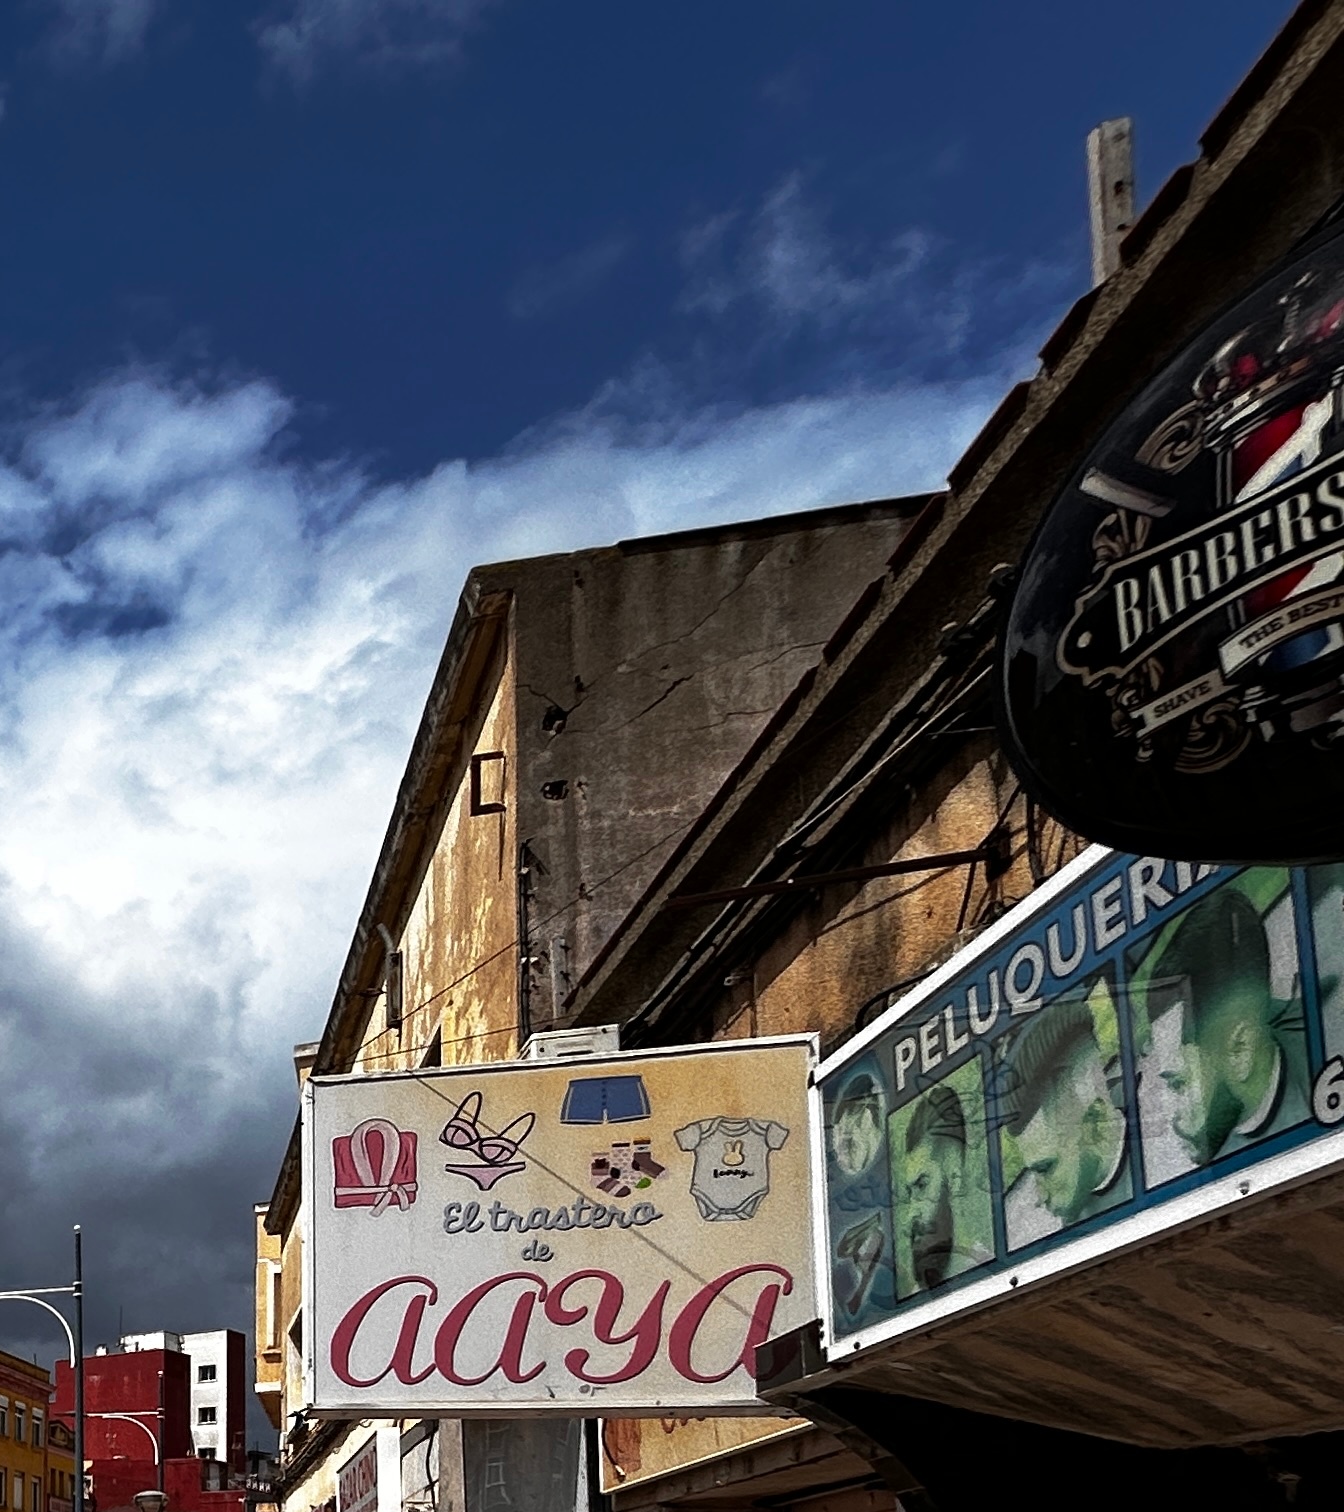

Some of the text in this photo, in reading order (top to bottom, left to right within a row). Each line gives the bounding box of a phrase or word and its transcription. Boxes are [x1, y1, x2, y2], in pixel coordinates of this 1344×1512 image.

[1114, 471, 1344, 653] BARBERS
[1239, 616, 1285, 648] THE
[1153, 680, 1211, 719] SHAVE
[443, 1195, 664, 1234] El trastero
[521, 1240, 554, 1262] de
